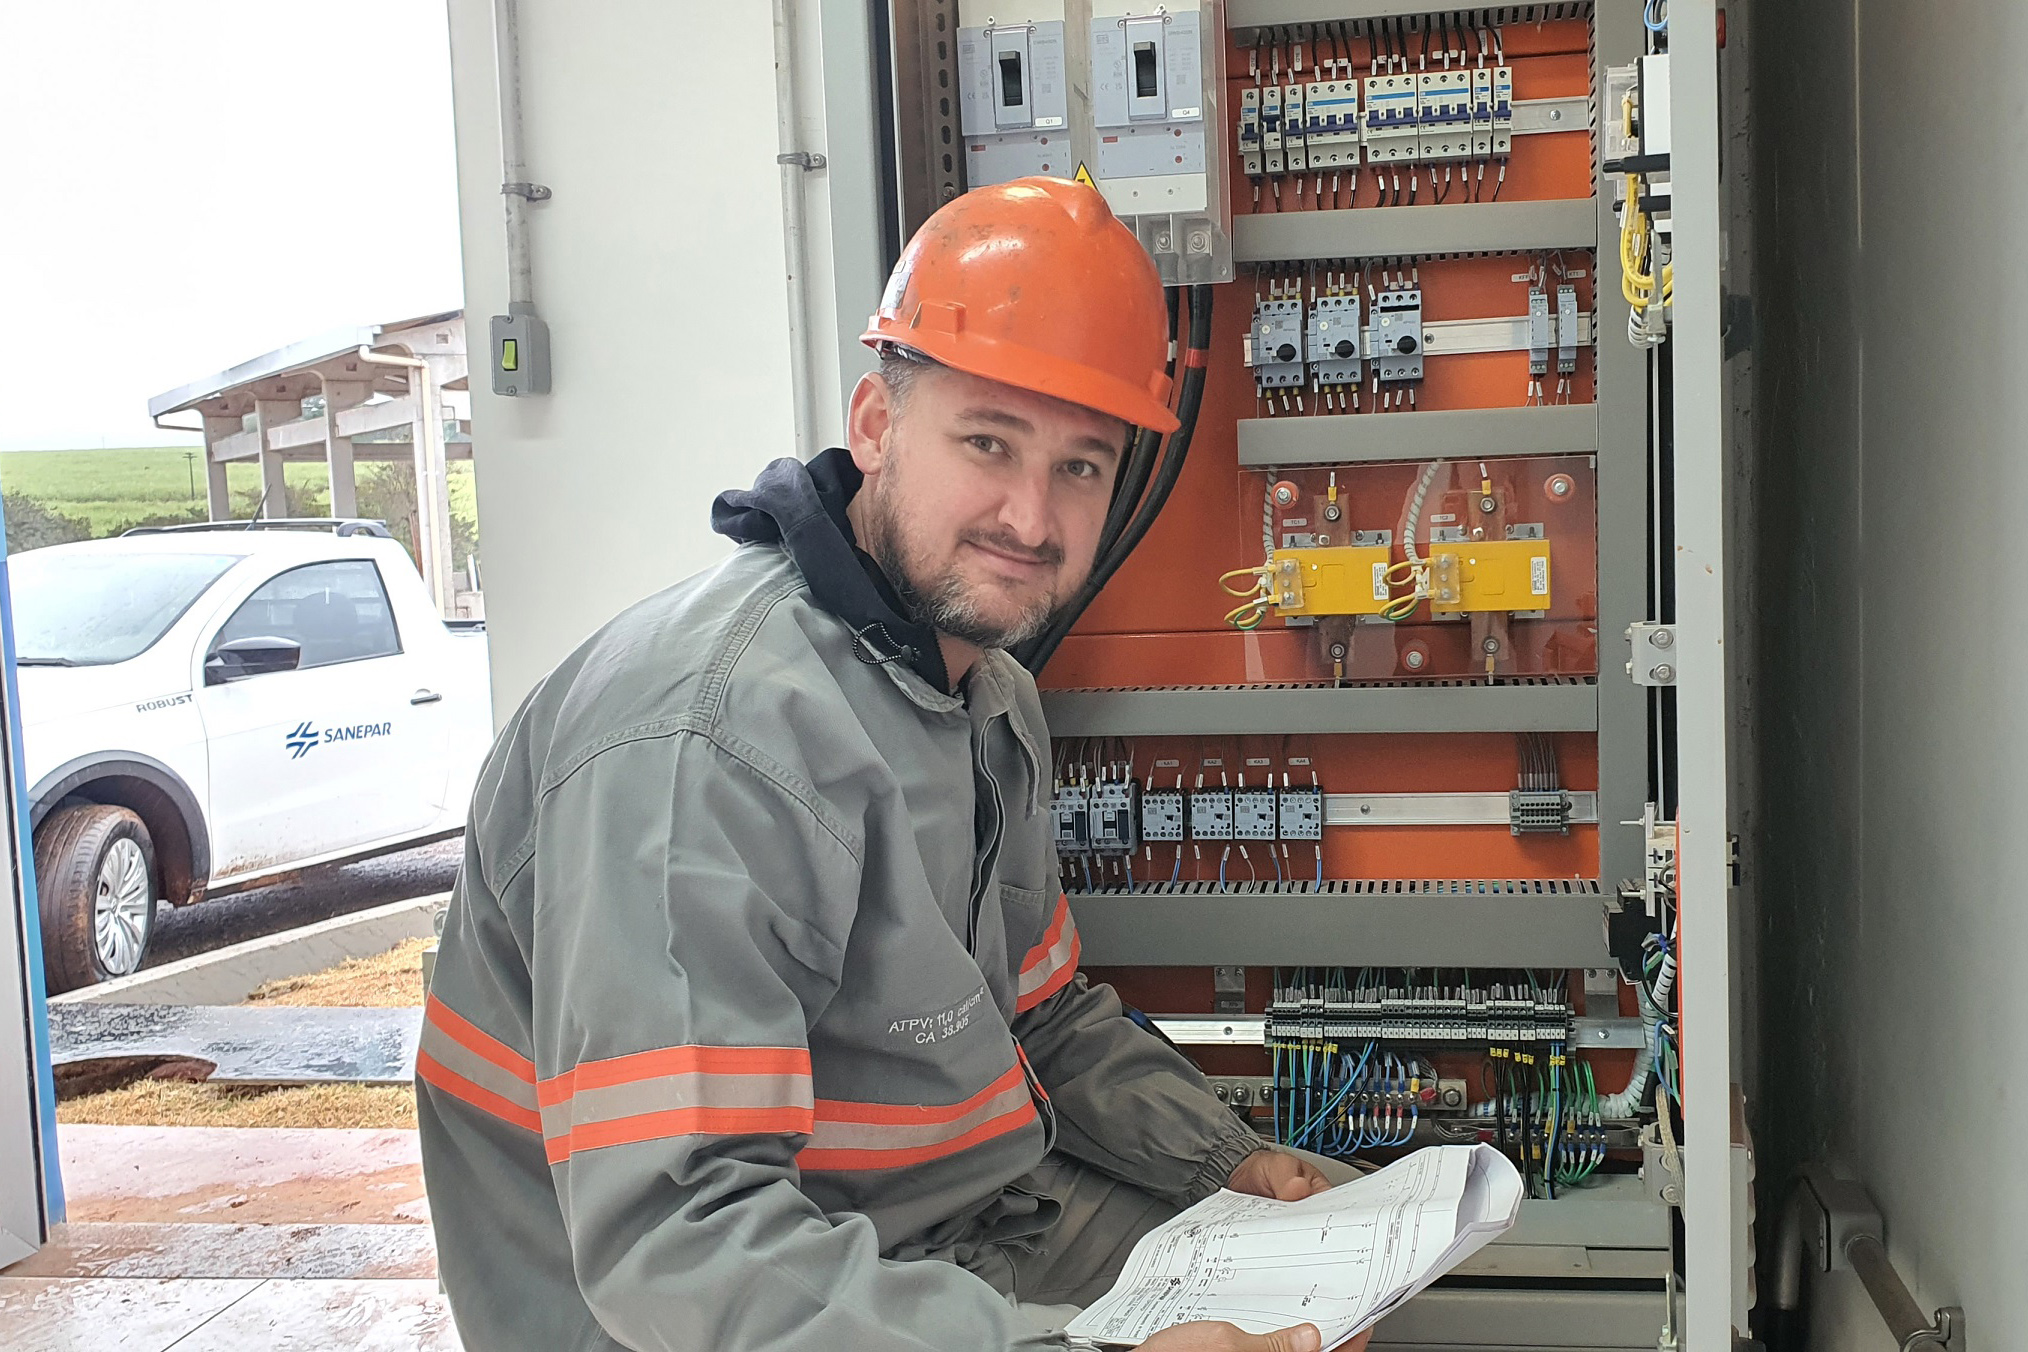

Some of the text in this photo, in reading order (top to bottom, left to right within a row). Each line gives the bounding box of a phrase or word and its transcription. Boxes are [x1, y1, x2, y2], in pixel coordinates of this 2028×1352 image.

[135, 693, 194, 713] ROBUST
[323, 721, 392, 743] SANEPAR
[889, 1017, 933, 1034] ATPV:
[915, 1032, 936, 1044] CA
